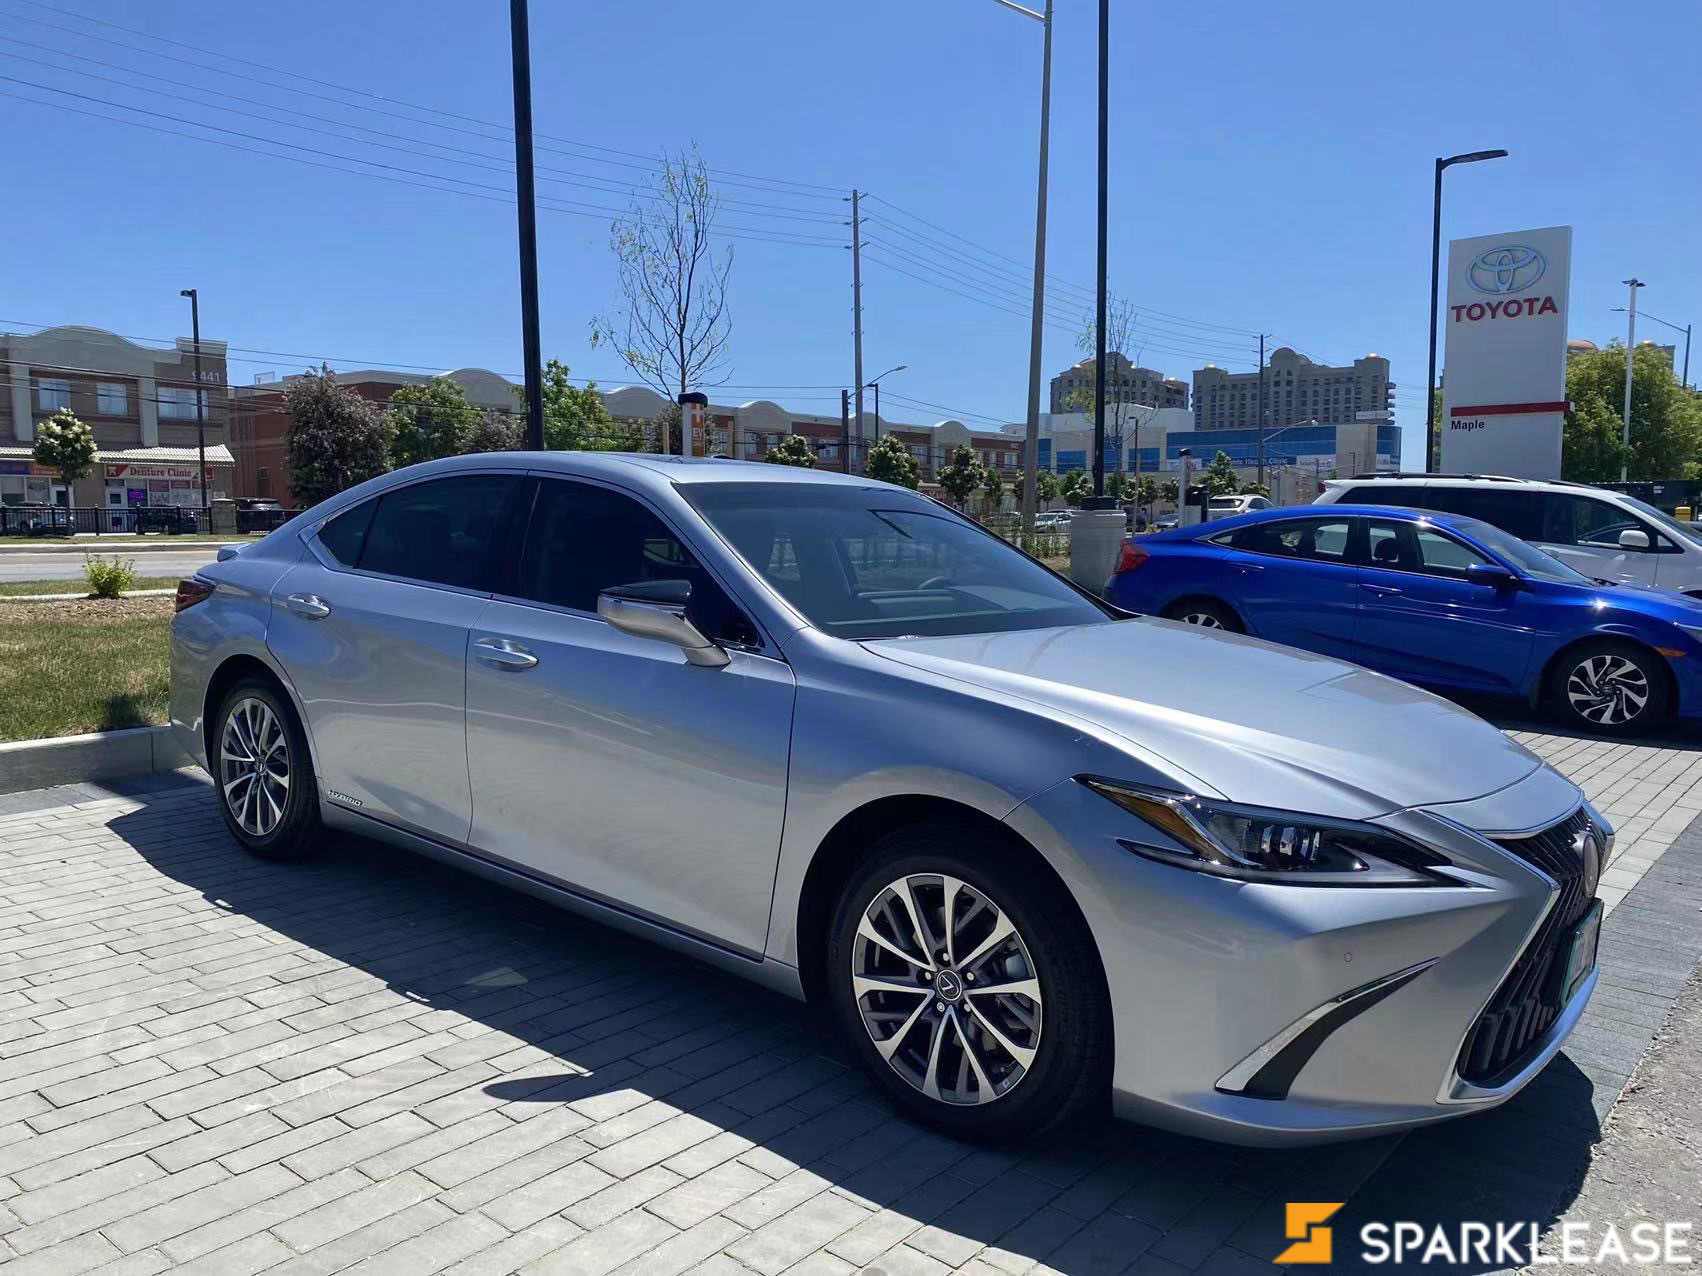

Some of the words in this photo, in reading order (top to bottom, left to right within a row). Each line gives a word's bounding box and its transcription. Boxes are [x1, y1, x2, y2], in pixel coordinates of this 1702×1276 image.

[1450, 296, 1558, 323] TOYOTA
[1451, 420, 1485, 433] Maple
[129, 467, 164, 477] Denture
[167, 467, 192, 477] Clinic
